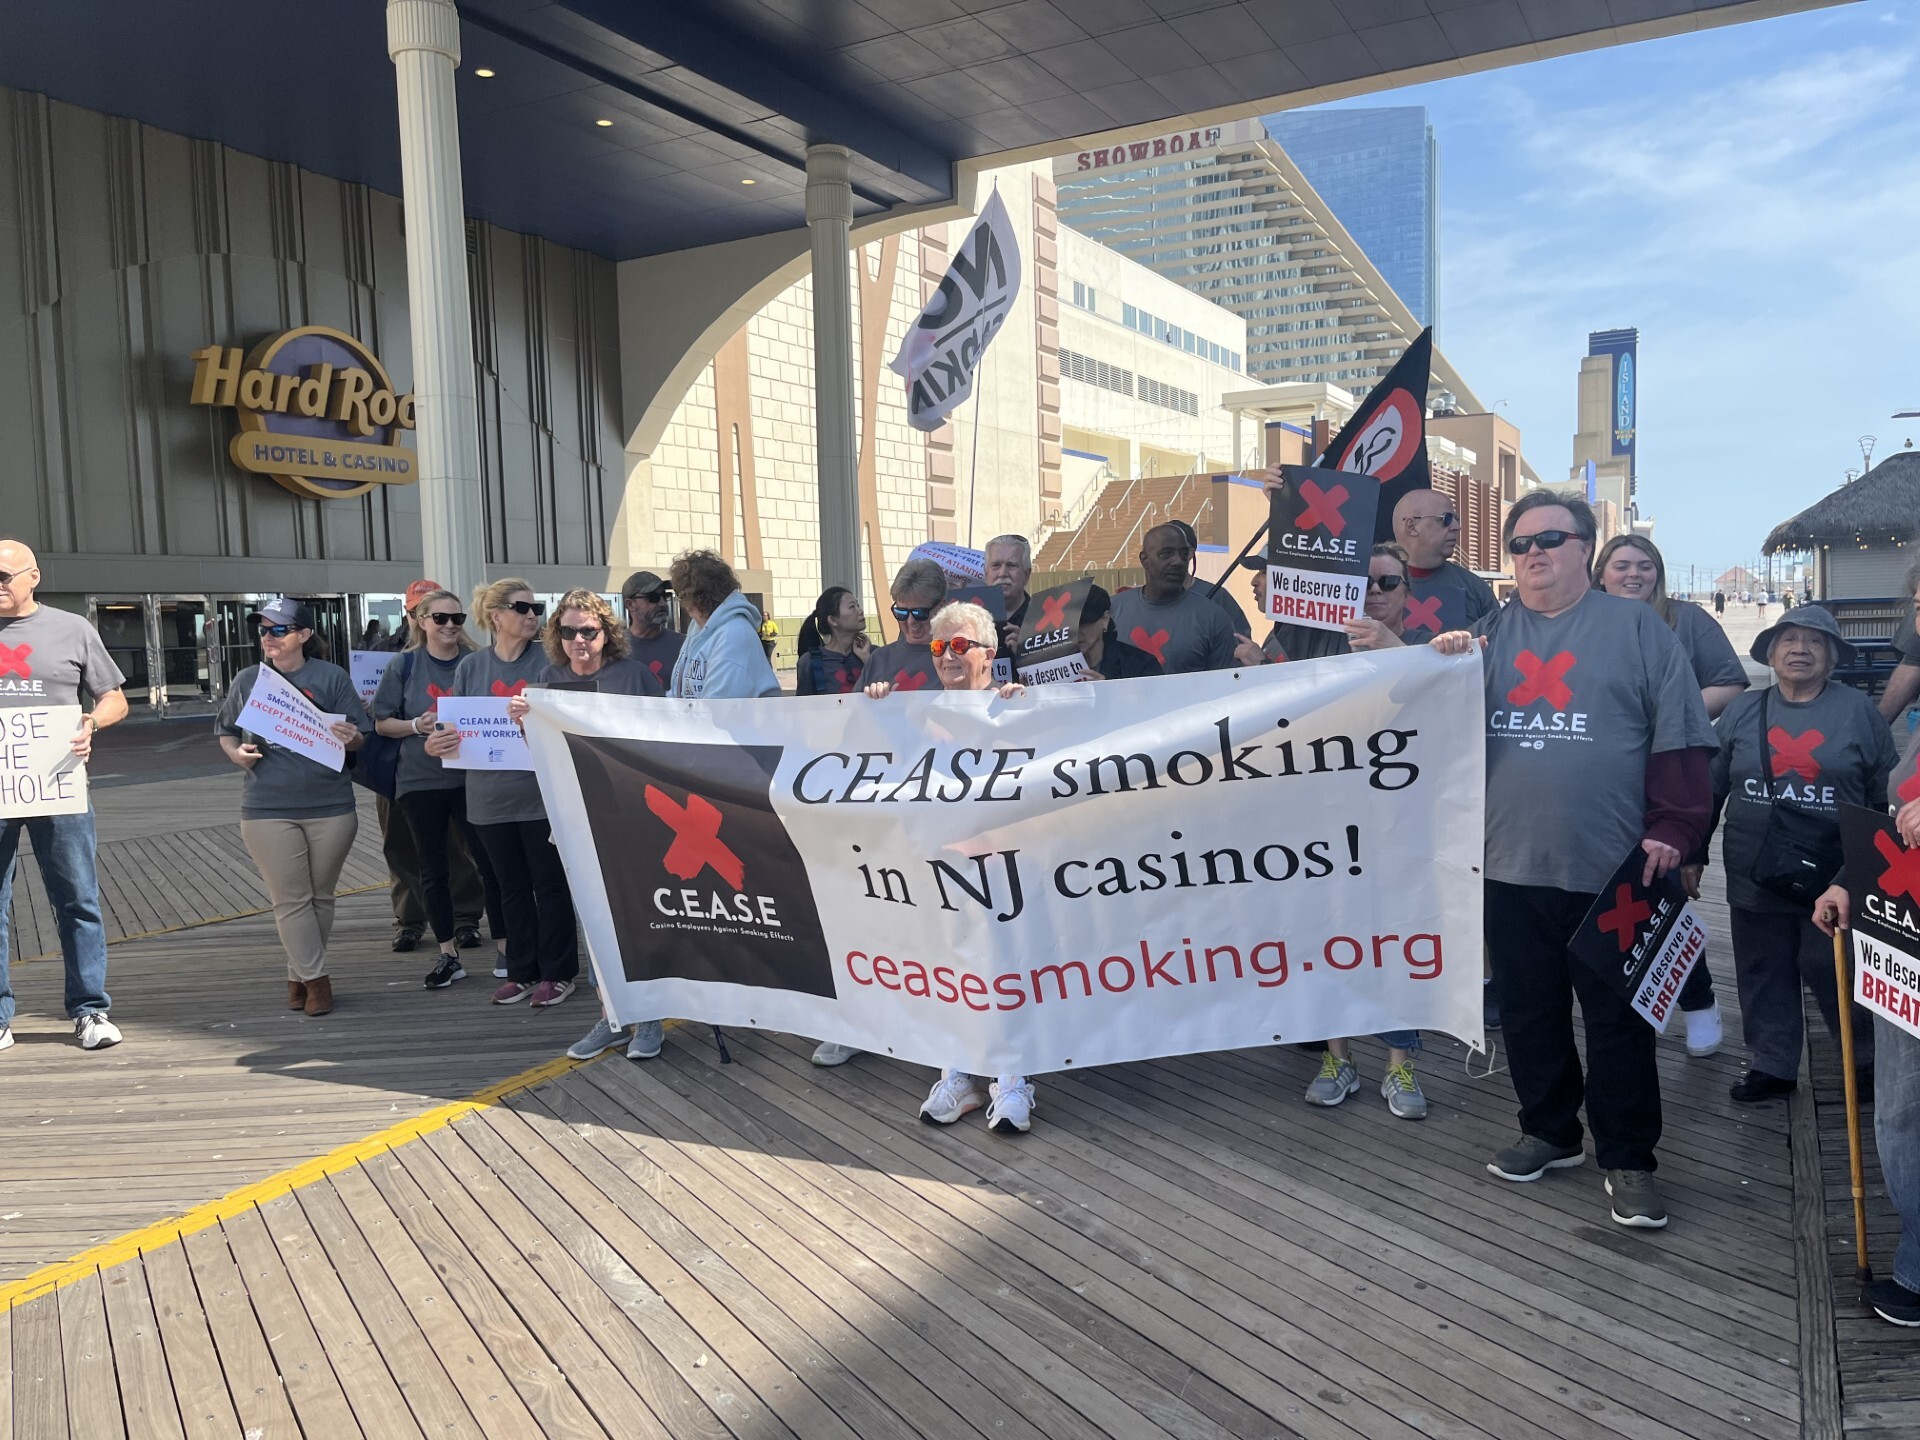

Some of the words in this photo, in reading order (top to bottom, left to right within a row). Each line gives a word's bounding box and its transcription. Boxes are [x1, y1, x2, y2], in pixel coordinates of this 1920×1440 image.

[1077, 127, 1220, 171] SHOWBOAT
[190, 345, 332, 418] Hard
[1620, 361, 1631, 427] ISLAND
[254, 443, 319, 466] HOTEL
[323, 451, 338, 467] &
[342, 453, 410, 474] CASINO
[1281, 533, 1358, 556] C.E.A.S.E
[946, 559, 984, 580] ATLANTIC
[1272, 571, 1289, 591] We
[1293, 574, 1341, 599] deserve
[1345, 582, 1360, 601] to
[1272, 594, 1356, 625] BREATHE!
[1024, 626, 1070, 650] C.E.A.S.E
[996, 663, 1007, 677] to
[1035, 665, 1070, 686] deserve
[280, 688, 290, 698] 20
[250, 698, 284, 720] EXCEPT
[284, 715, 324, 741] ATLANTIC
[325, 736, 342, 752] CITY
[267, 693, 317, 726] SMOKE-FREE
[459, 717, 491, 726] CLEAN
[493, 717, 508, 725] AIR
[1490, 710, 1588, 733] C.E.A.S.E
[274, 724, 314, 748] CASINOS
[792, 746, 1036, 805] CEASE
[1051, 715, 1420, 791] smoking
[1, 771, 75, 804] HOLE
[851, 844, 917, 907] in
[926, 848, 1024, 923] NJ
[1053, 824, 1363, 900] casinos!
[653, 887, 782, 928] C.E.A.S.E
[650, 922, 675, 930] Casino
[676, 922, 711, 931] Employees
[713, 925, 738, 934] Against
[740, 927, 769, 939] Smoking
[770, 931, 794, 941] Effects
[1622, 897, 1671, 977] C.E.A.S.E
[1637, 985, 1656, 1009] We
[1651, 930, 1684, 983] deserve
[1680, 914, 1693, 931] to
[1860, 940, 1881, 971] We
[845, 931, 1444, 1013] ceasesmoking.org
[1651, 925, 1706, 1024] BREATHE!
